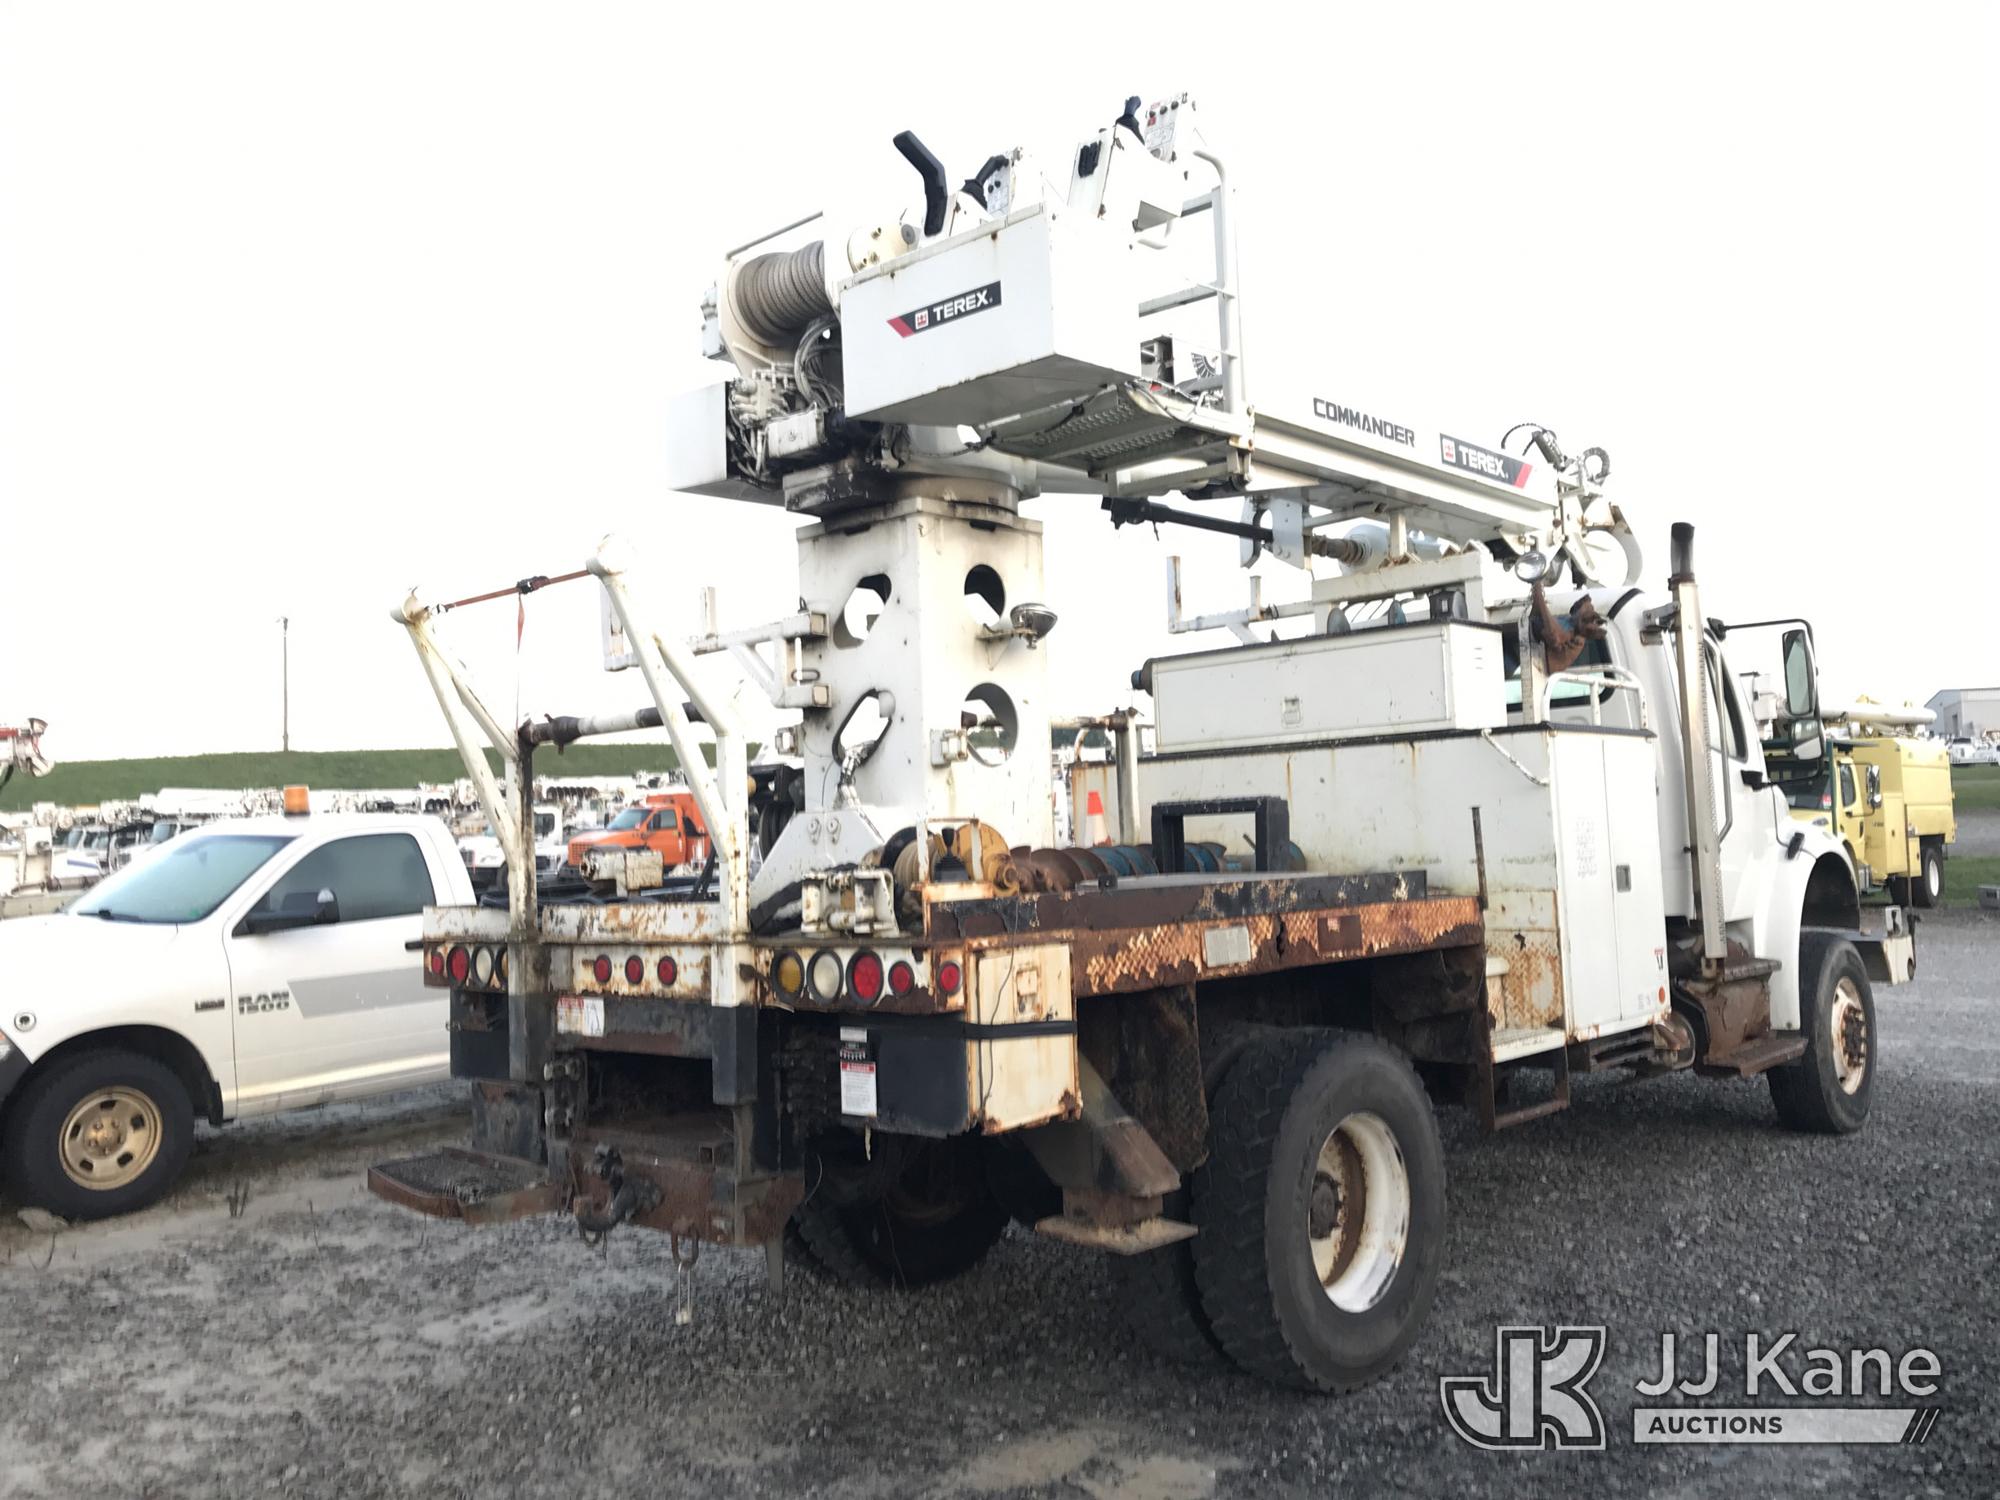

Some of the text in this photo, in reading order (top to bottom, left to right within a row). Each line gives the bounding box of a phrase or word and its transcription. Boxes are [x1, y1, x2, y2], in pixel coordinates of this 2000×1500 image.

[932, 289, 989, 322] TEREX
[1312, 396, 1416, 449] COMMANDER
[1457, 444, 1507, 480] TEREX
[238, 991, 290, 1006] RAM
